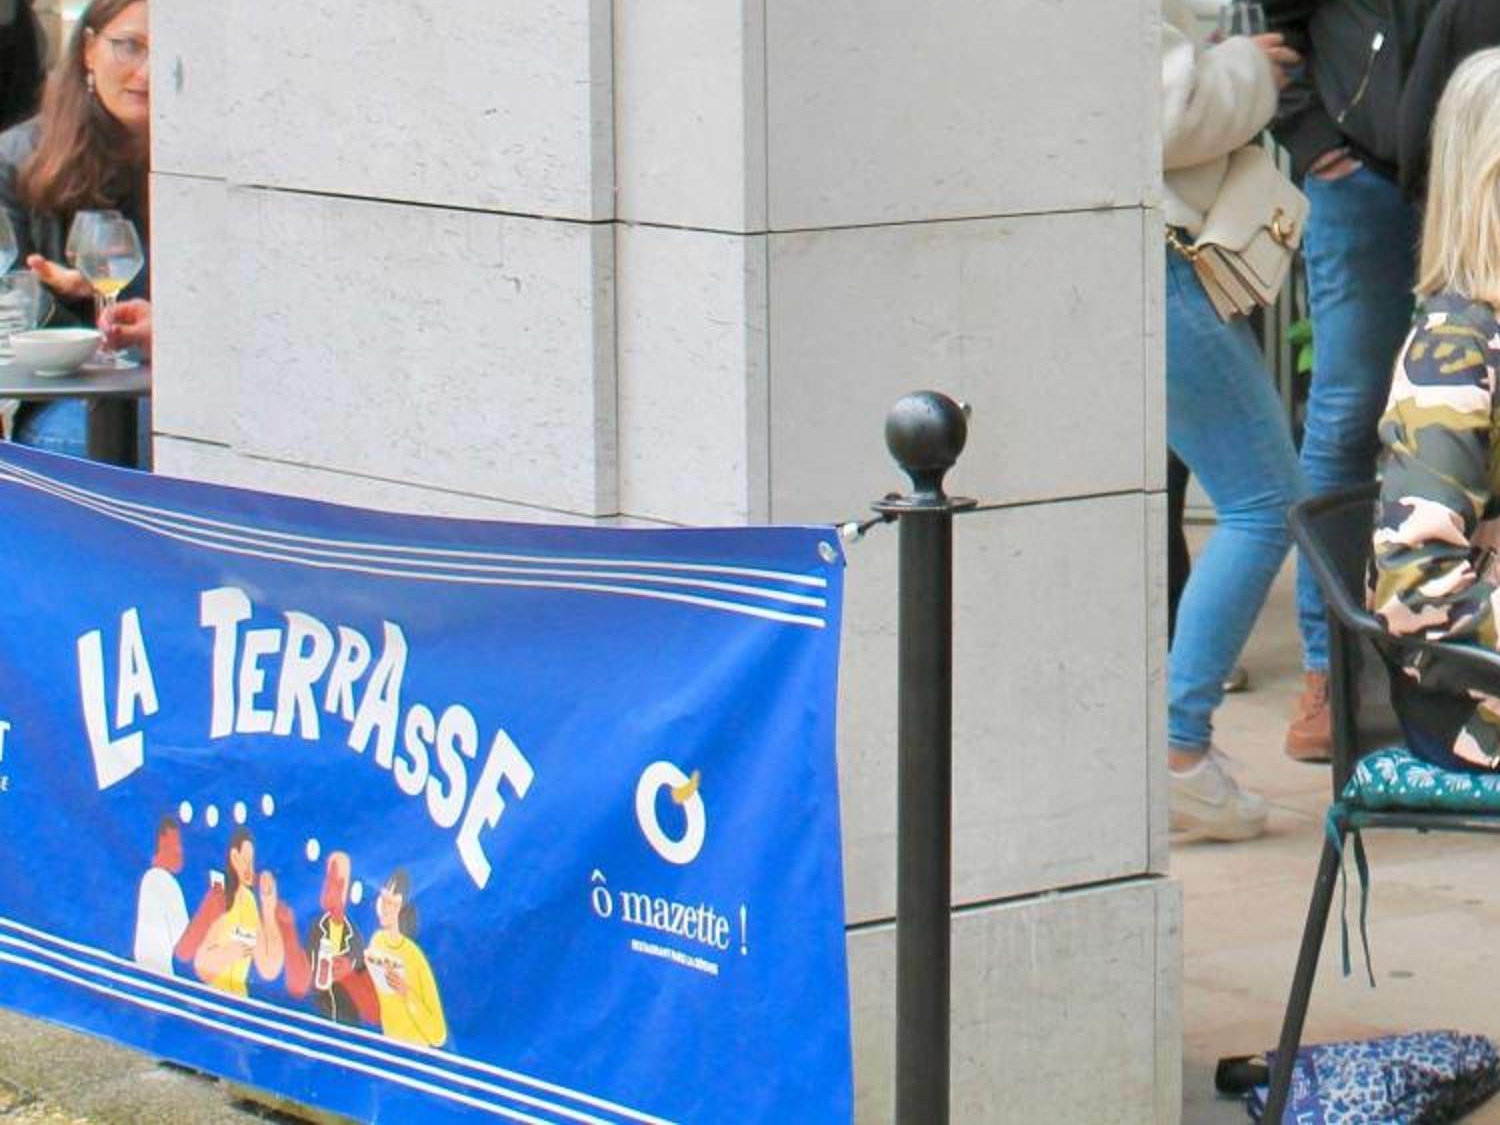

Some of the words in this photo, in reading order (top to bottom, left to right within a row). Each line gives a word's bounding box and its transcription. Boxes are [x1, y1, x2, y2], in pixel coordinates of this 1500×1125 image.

[77, 607, 159, 791] LA
[201, 586, 535, 890] TERRASSE
[620, 890, 730, 950] mazette
